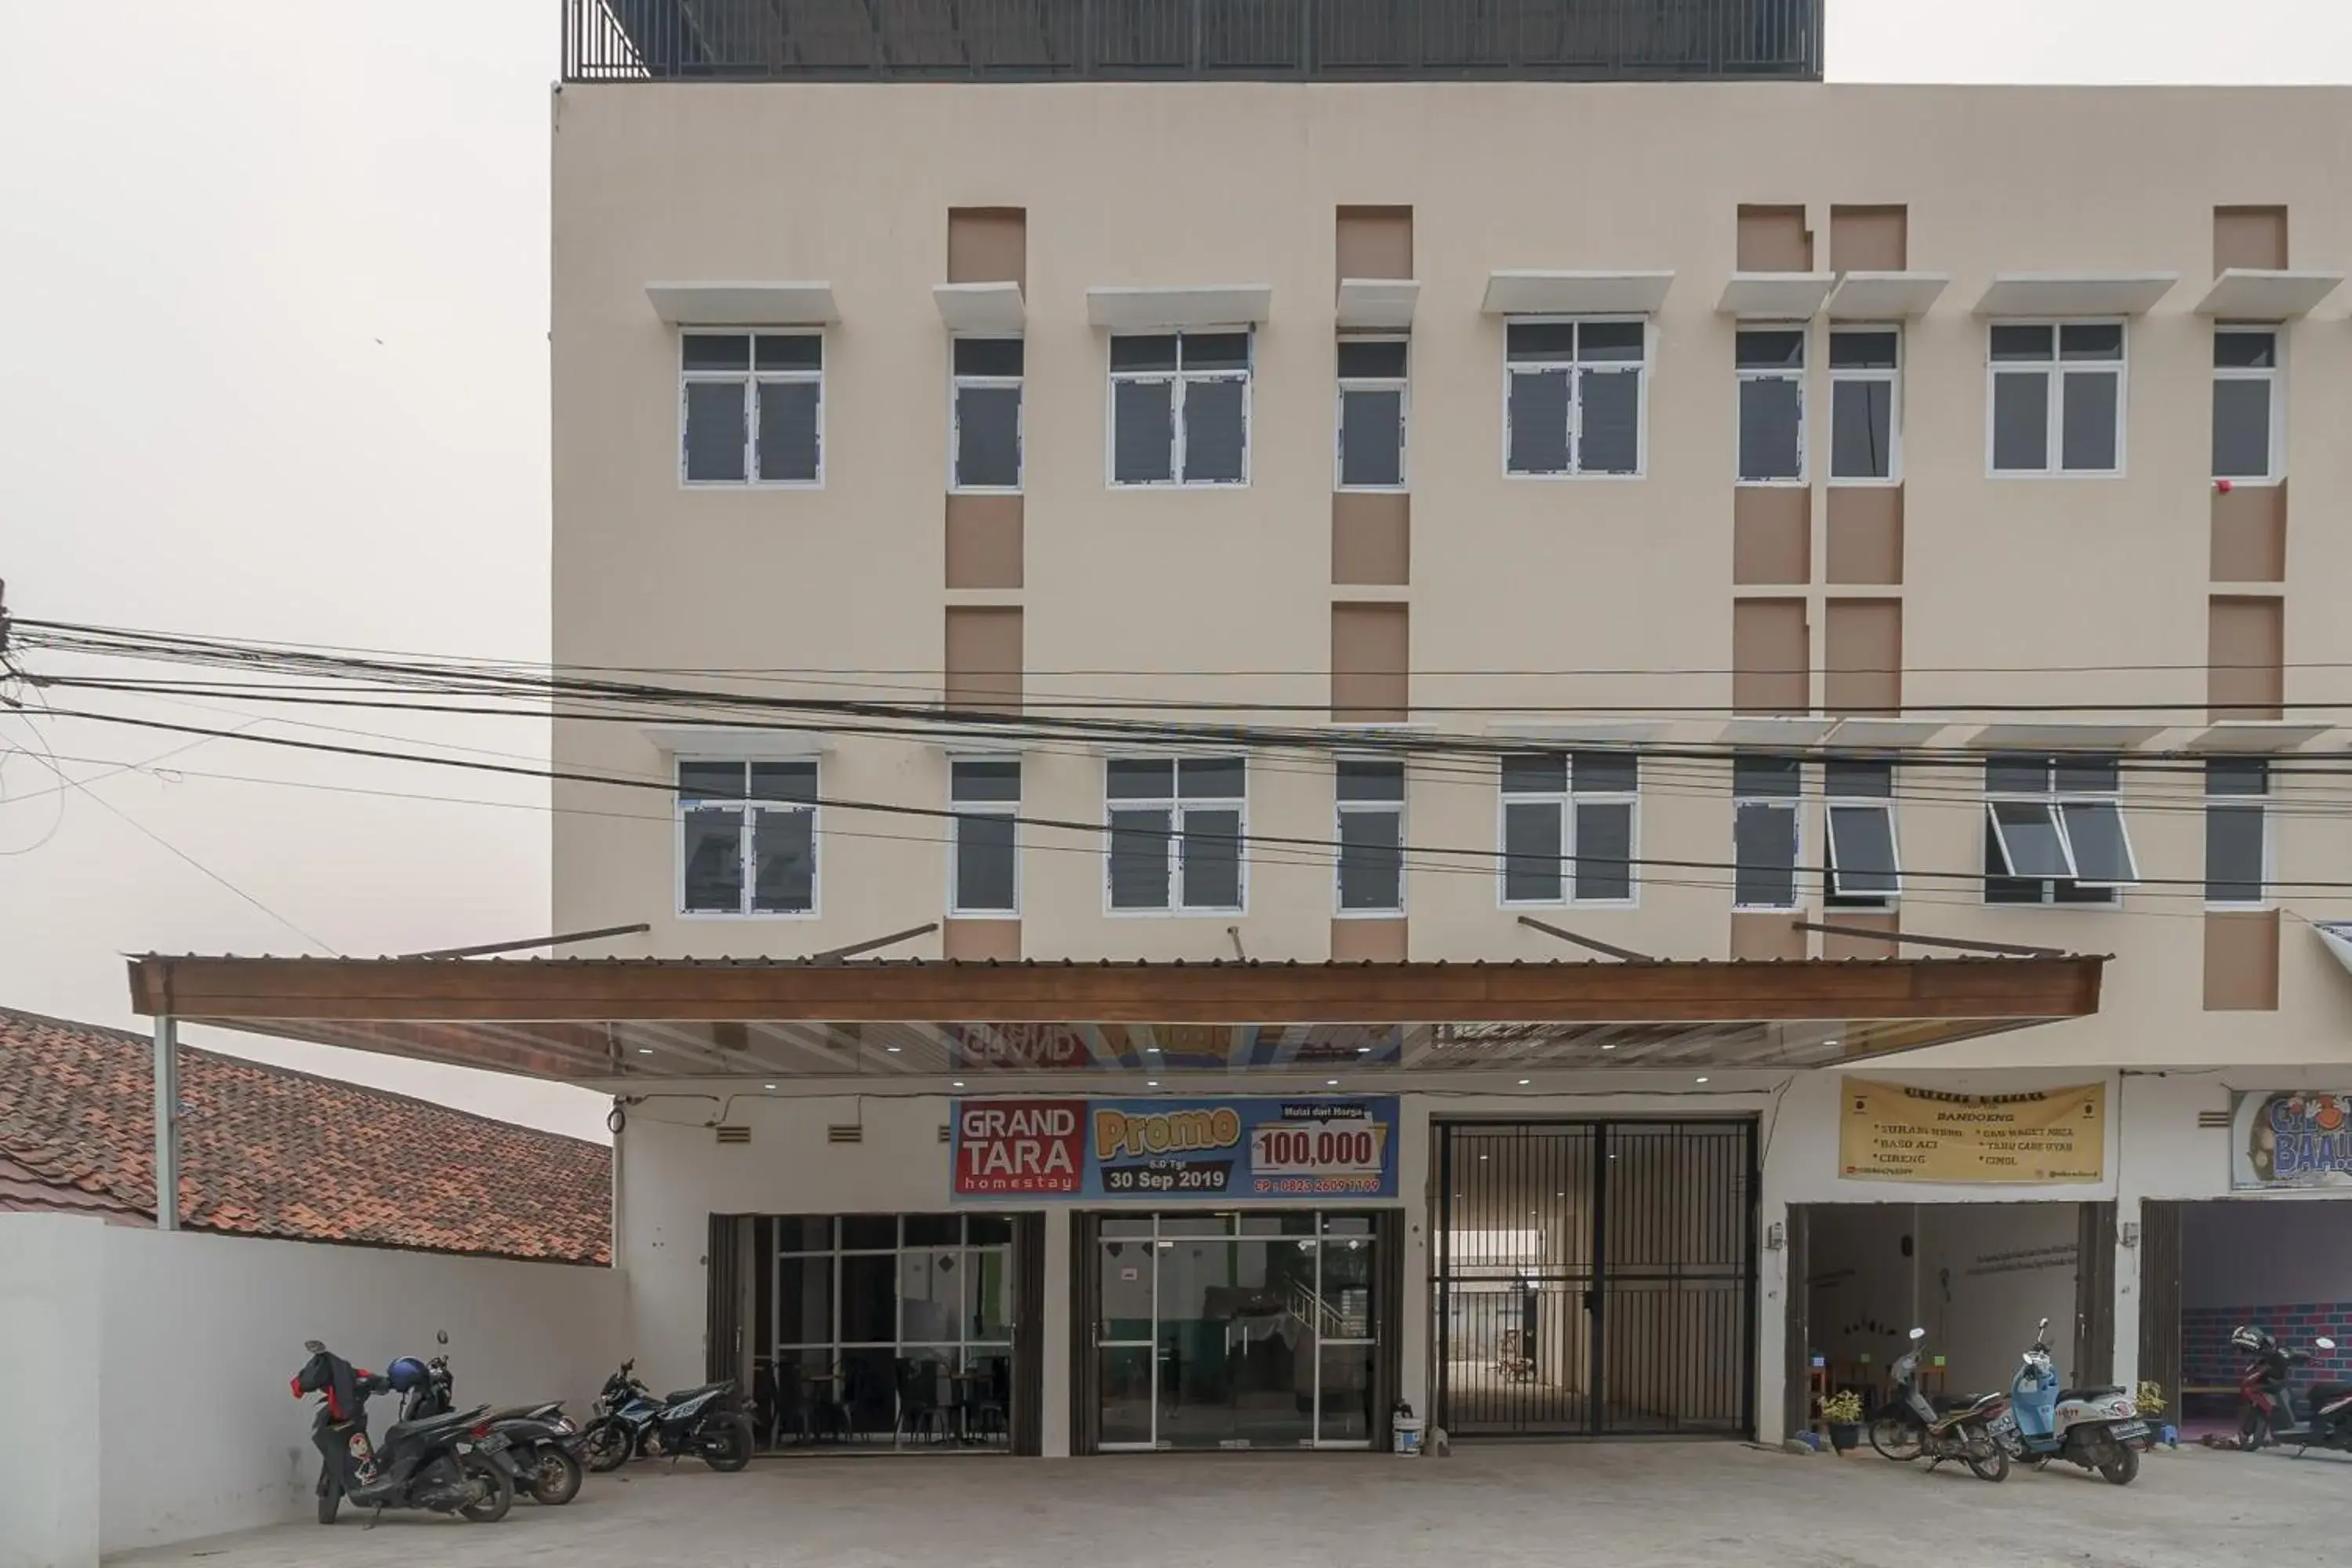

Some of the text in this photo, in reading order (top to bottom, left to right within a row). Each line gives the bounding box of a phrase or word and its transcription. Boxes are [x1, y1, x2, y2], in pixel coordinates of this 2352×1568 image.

[962, 1109, 1075, 1138] GRAND
[1937, 1112, 2015, 1123] BANDOENG
[1094, 1108, 1240, 1160] Promo
[962, 1139, 1074, 1175] TARA
[1260, 1131, 1371, 1167] 100,000
[965, 1176, 1073, 1191] homestay
[1109, 1171, 1224, 1190] 30 Sep 2019
